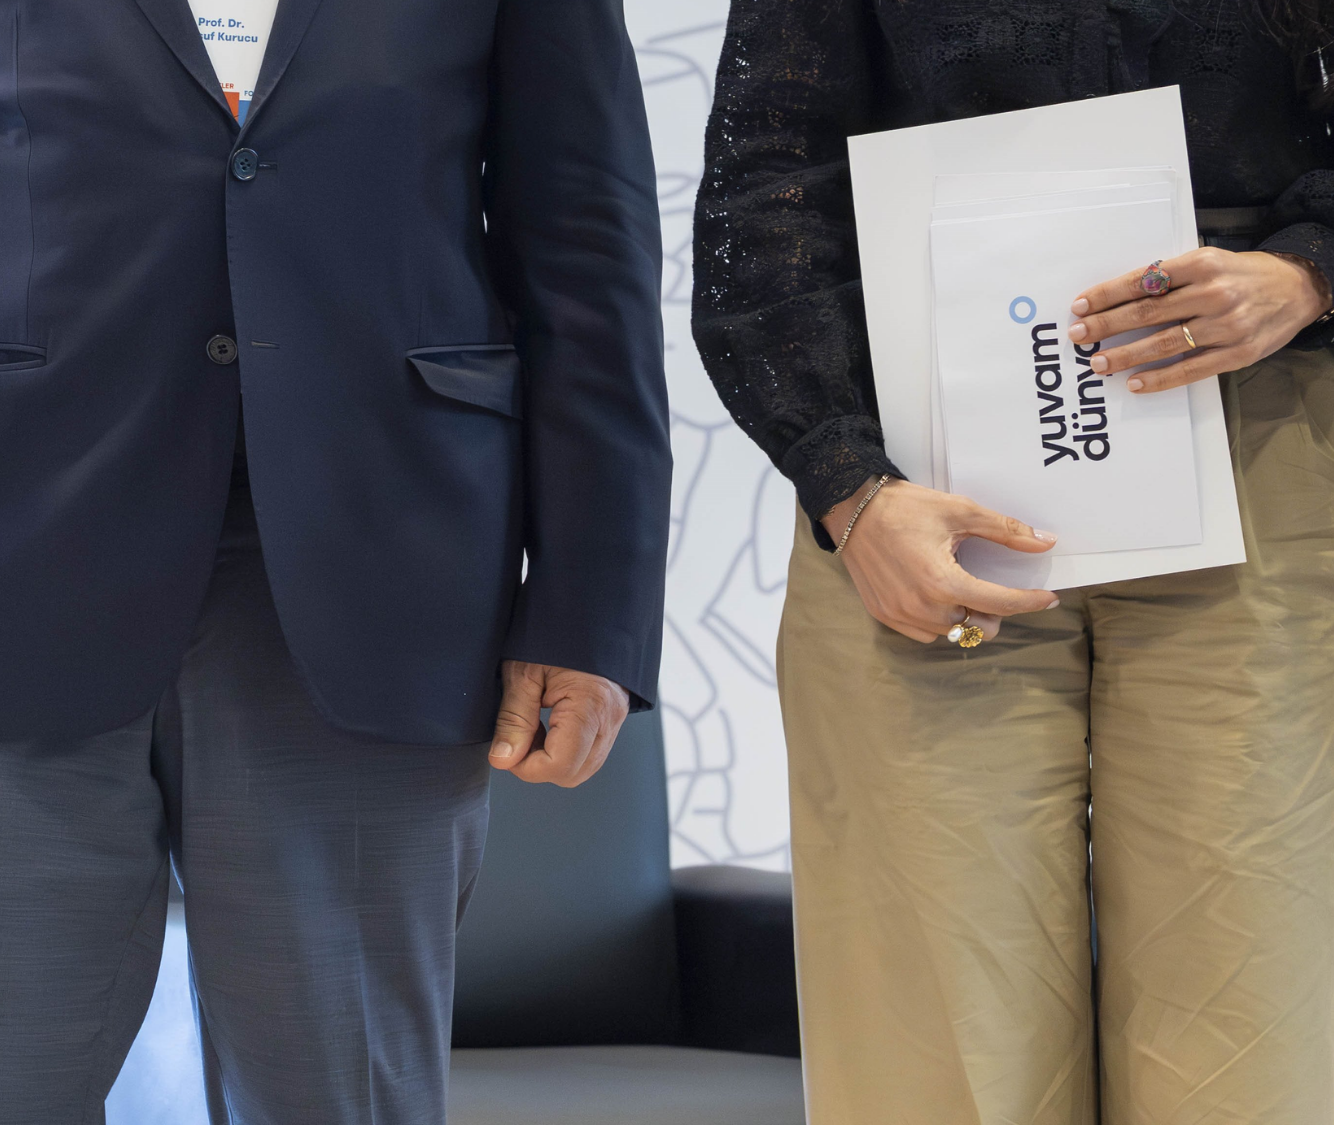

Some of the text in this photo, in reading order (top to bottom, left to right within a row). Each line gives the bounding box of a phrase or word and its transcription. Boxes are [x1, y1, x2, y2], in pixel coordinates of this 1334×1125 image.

[198, 17, 245, 28] Prof. Dr.
[217, 32, 258, 43] Kurucu
[1031, 322, 1079, 467] yuvam
